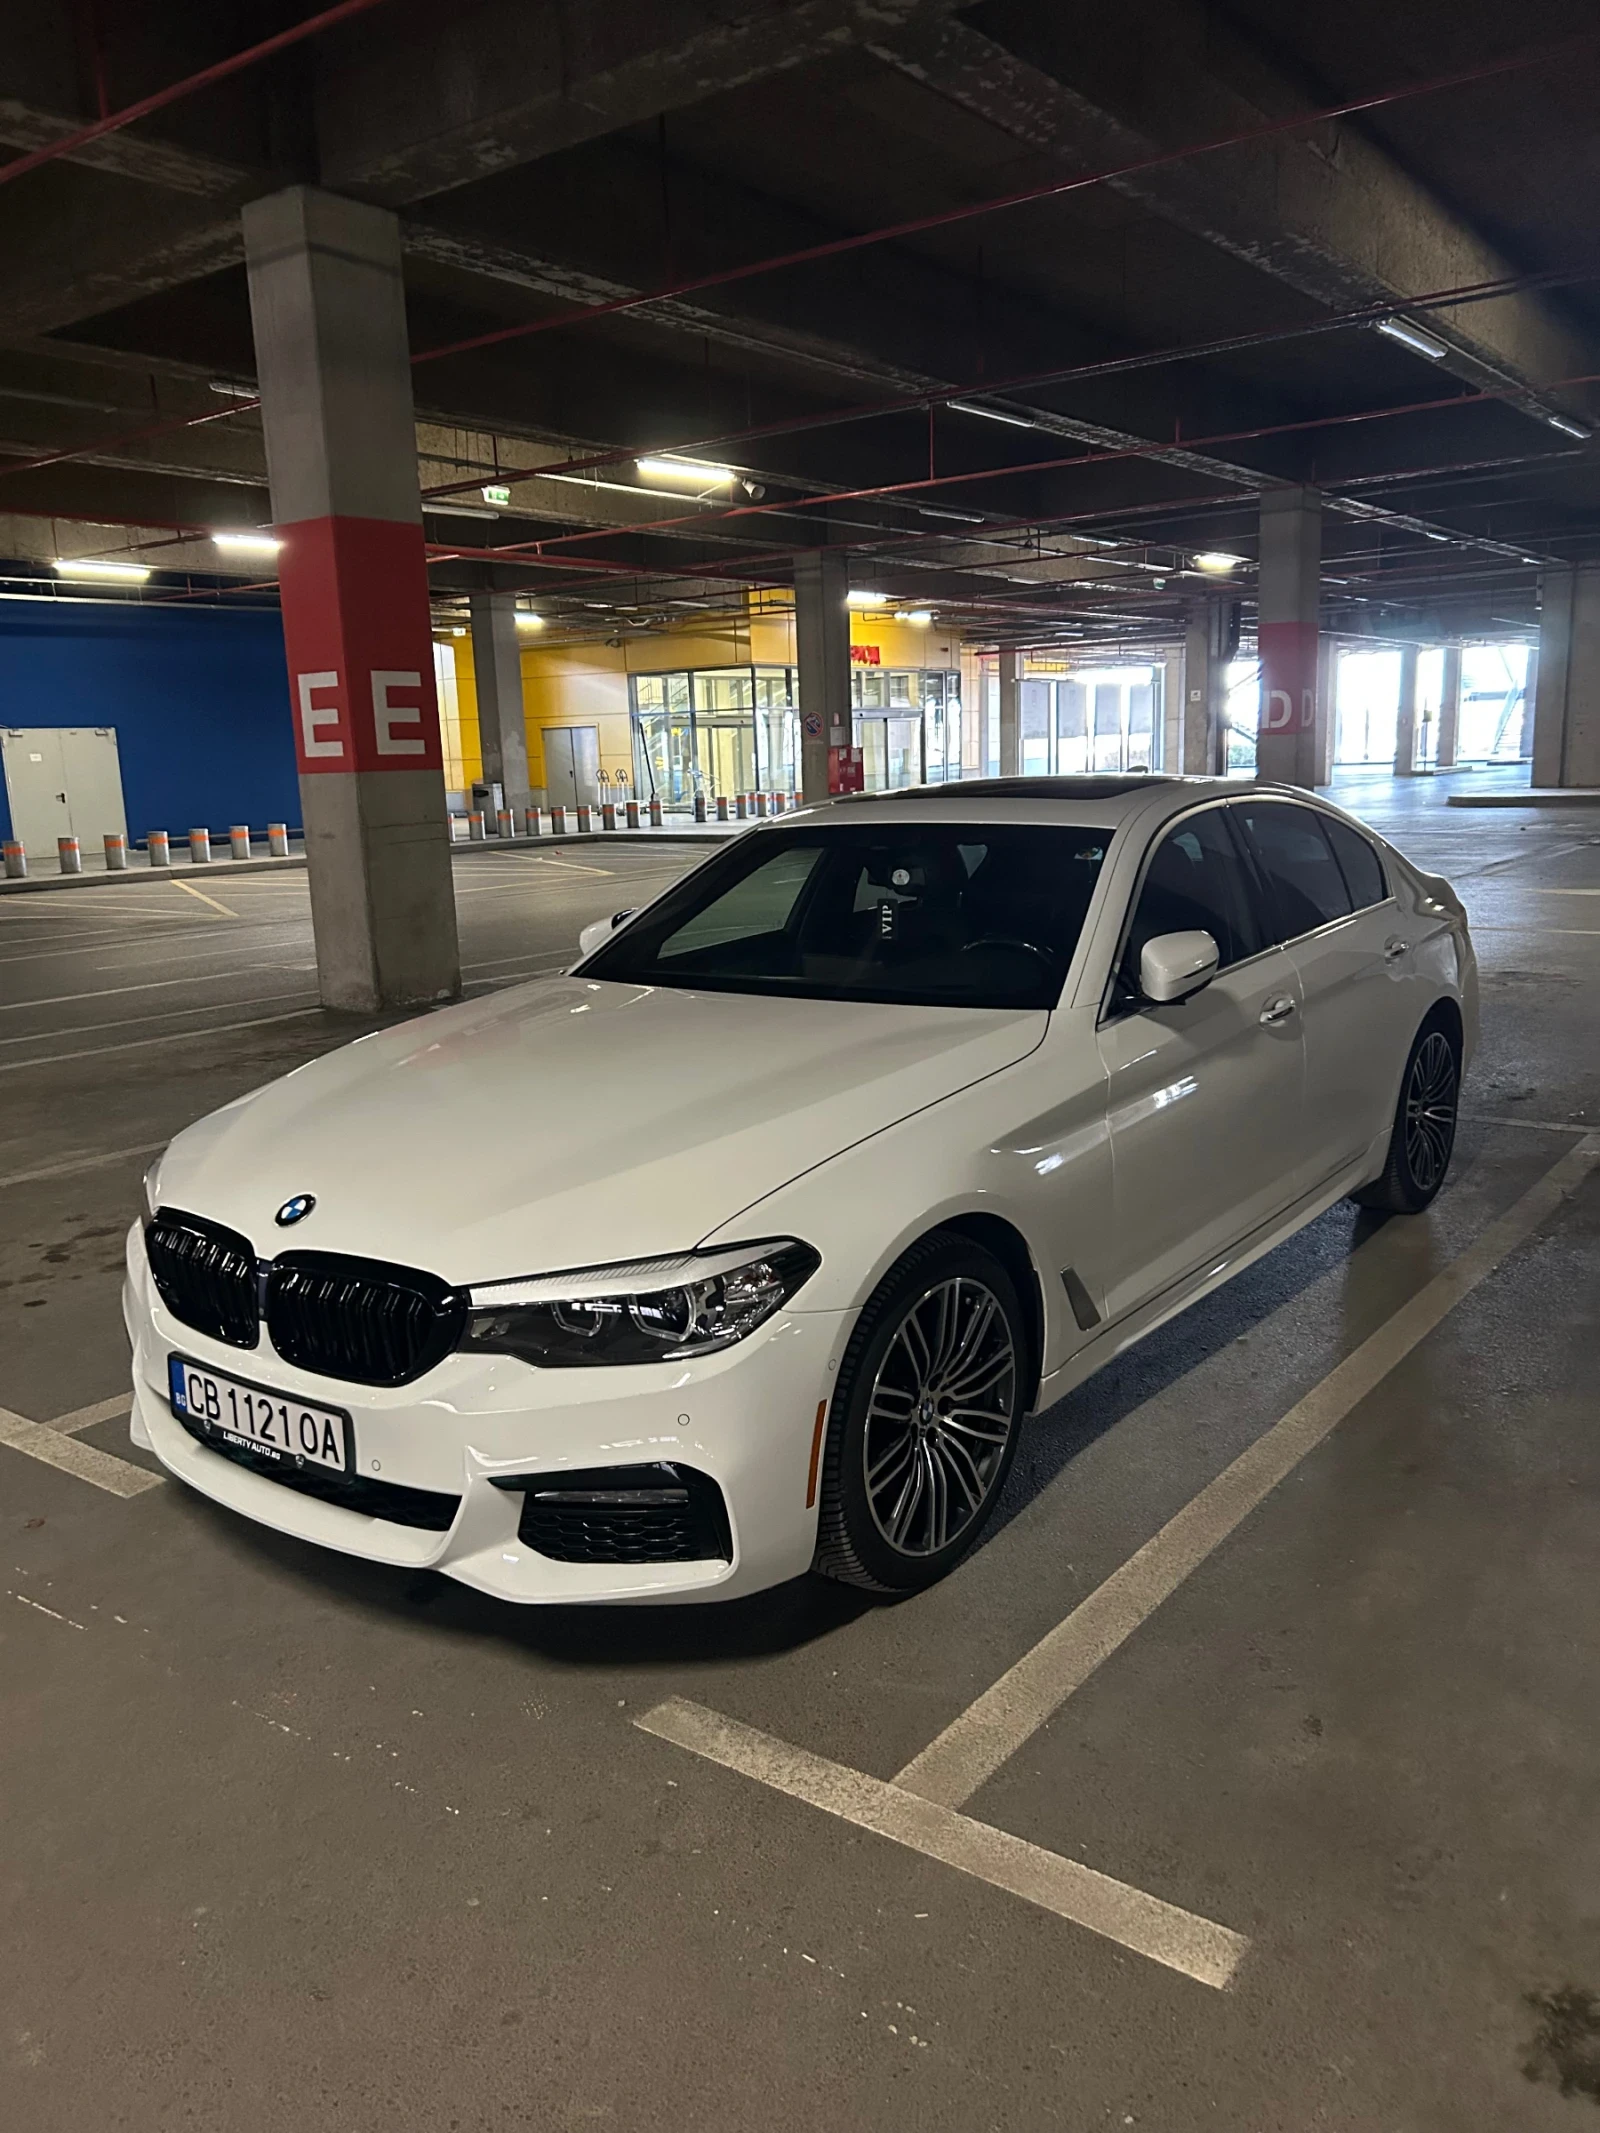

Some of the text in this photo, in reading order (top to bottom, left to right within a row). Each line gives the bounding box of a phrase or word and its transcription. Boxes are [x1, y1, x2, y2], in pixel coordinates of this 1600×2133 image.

[298, 671, 344, 757] E
[370, 670, 426, 755] E
[1261, 690, 1293, 729] D
[1301, 688, 1314, 728] D
[881, 904, 893, 934] VIP
[175, 1391, 187, 1407] BG
[223, 1431, 251, 1449] LIBERTY
